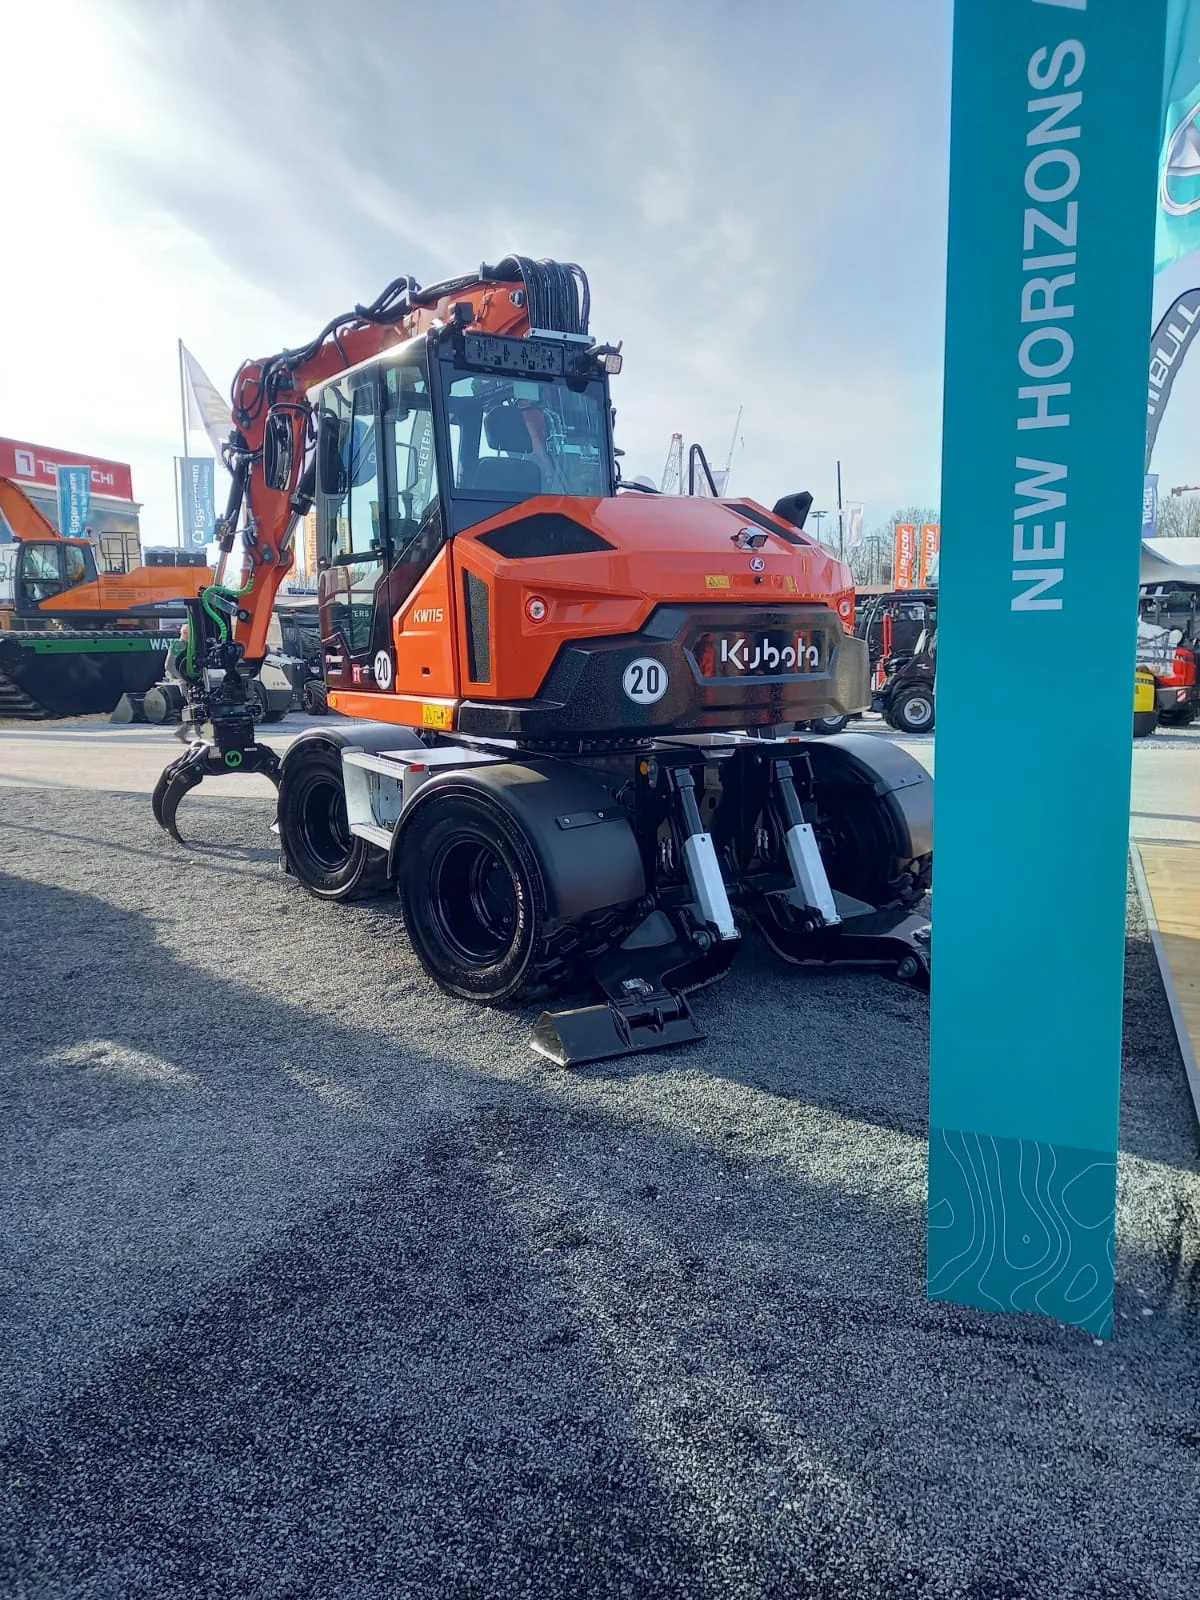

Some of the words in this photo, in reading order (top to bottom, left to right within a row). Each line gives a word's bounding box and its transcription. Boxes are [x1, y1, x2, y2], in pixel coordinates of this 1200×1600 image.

[1017, 38, 1086, 431] HORIZONS
[1147, 303, 1200, 416] BULL
[37, 459, 114, 486] TACHI
[69, 472, 81, 535] Eggersmann
[191, 464, 205, 529] Eggersmann
[1010, 455, 1068, 613] NEW
[376, 657, 389, 681] 20
[630, 665, 659, 695] 20
[720, 637, 819, 670] Kubota
